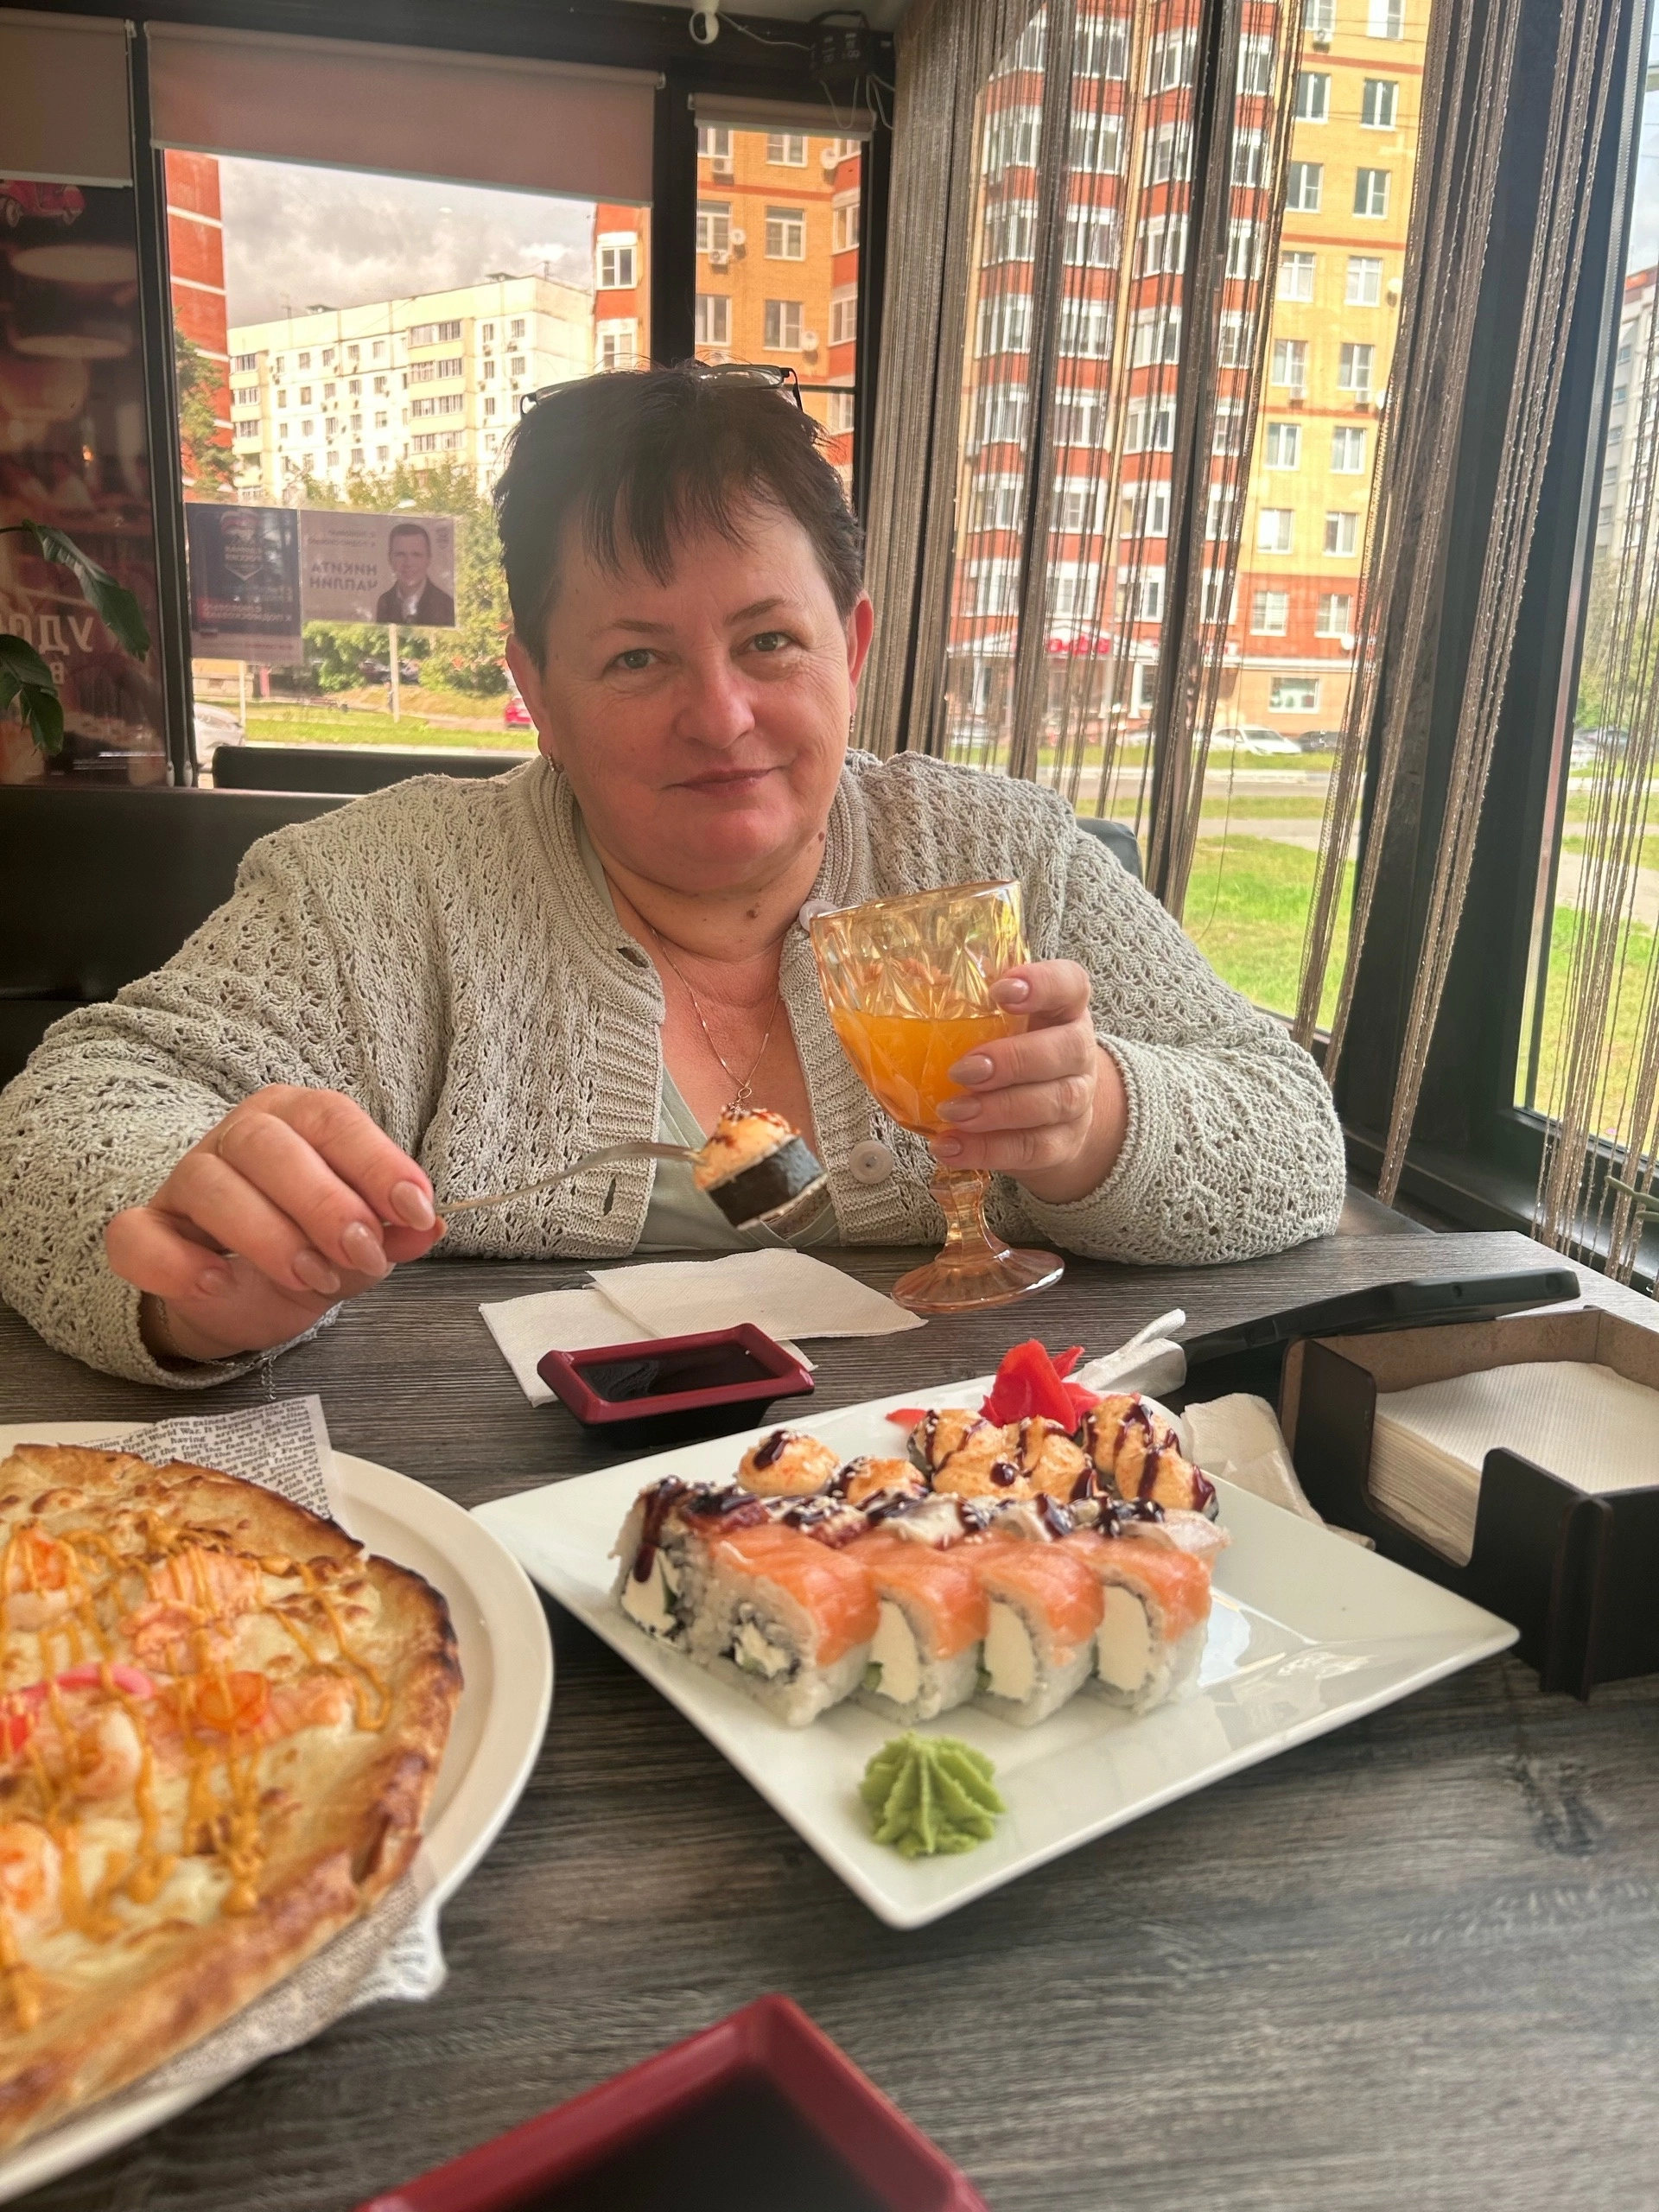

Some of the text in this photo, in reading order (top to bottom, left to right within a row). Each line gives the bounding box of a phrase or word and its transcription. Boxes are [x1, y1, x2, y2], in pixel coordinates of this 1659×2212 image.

[149, 1427, 177, 1442] World
[215, 1413, 264, 1431] happened
[265, 1408, 285, 1418] like
[161, 1421, 190, 1430] wives
[193, 1416, 226, 1427] gained
[230, 1403, 280, 1421] worldwide
[170, 1434, 207, 1445] having
[215, 1423, 253, 1439] arrived
[281, 1408, 309, 1420] allied
[160, 1446, 177, 1456] the
[214, 1435, 232, 1446] and
[238, 1428, 262, 1440] were
[183, 1449, 201, 1460] But
[226, 1440, 245, 1450] fact
[261, 1427, 282, 1440] that
[286, 1421, 312, 1432] some
[274, 1437, 296, 1449] And
[298, 1433, 315, 1443] the
[281, 1429, 300, 1440] one
[302, 1426, 312, 1434] of
[281, 1440, 317, 1455] French
[251, 1459, 270, 1472] and
[274, 1452, 299, 1465] fries
